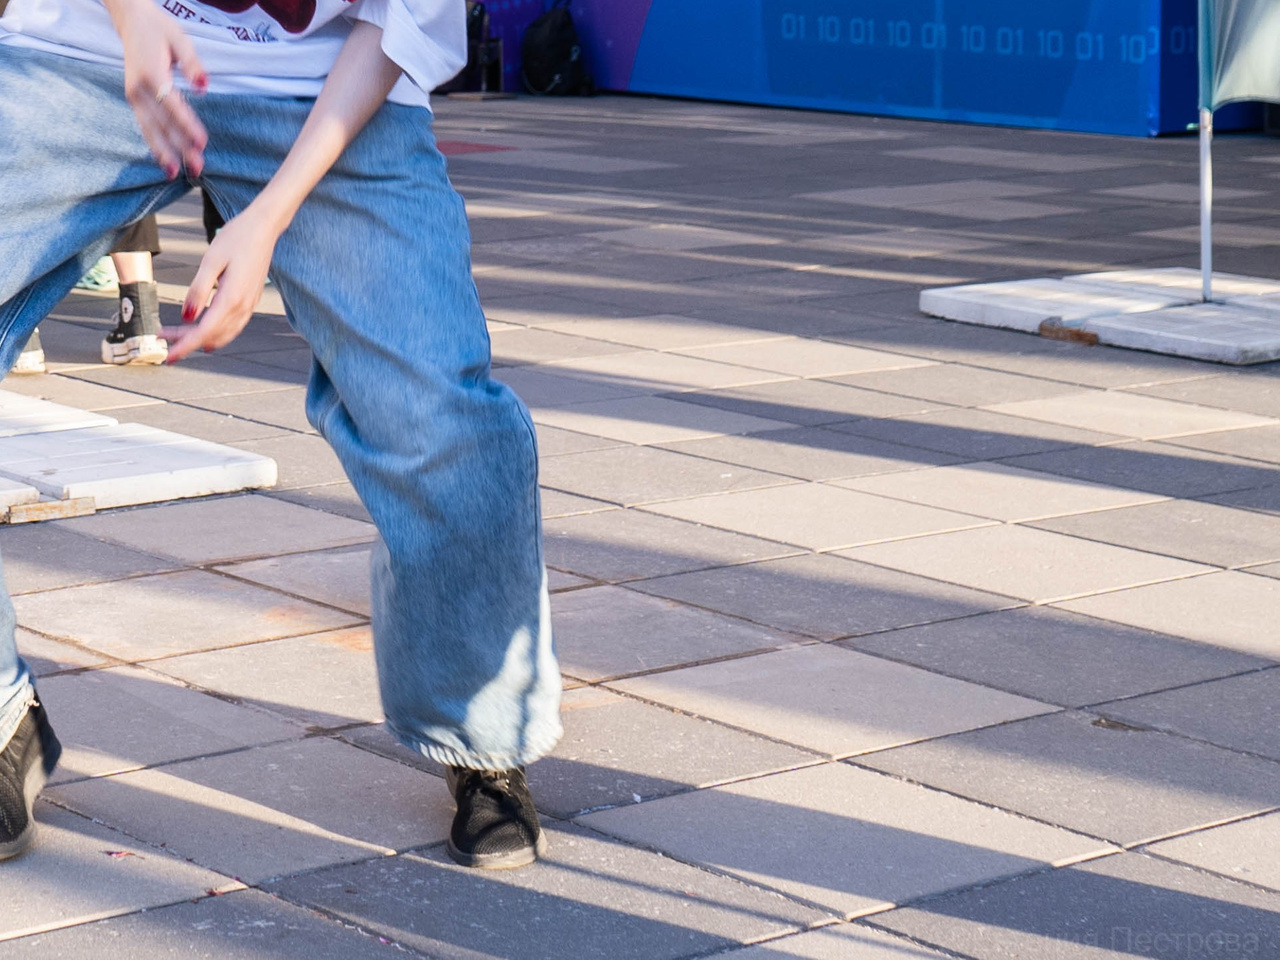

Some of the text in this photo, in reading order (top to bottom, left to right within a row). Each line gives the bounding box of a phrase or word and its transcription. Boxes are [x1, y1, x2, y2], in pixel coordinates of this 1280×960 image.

[781, 13, 806, 40] 01
[817, 15, 840, 43] 10
[849, 17, 874, 46] 01
[886, 20, 911, 47] 10
[922, 22, 947, 50] 01
[961, 25, 986, 53] 10
[996, 26, 1024, 55] 01
[1037, 29, 1064, 58] 10
[1076, 31, 1104, 61] 01
[1120, 34, 1147, 65] 10
